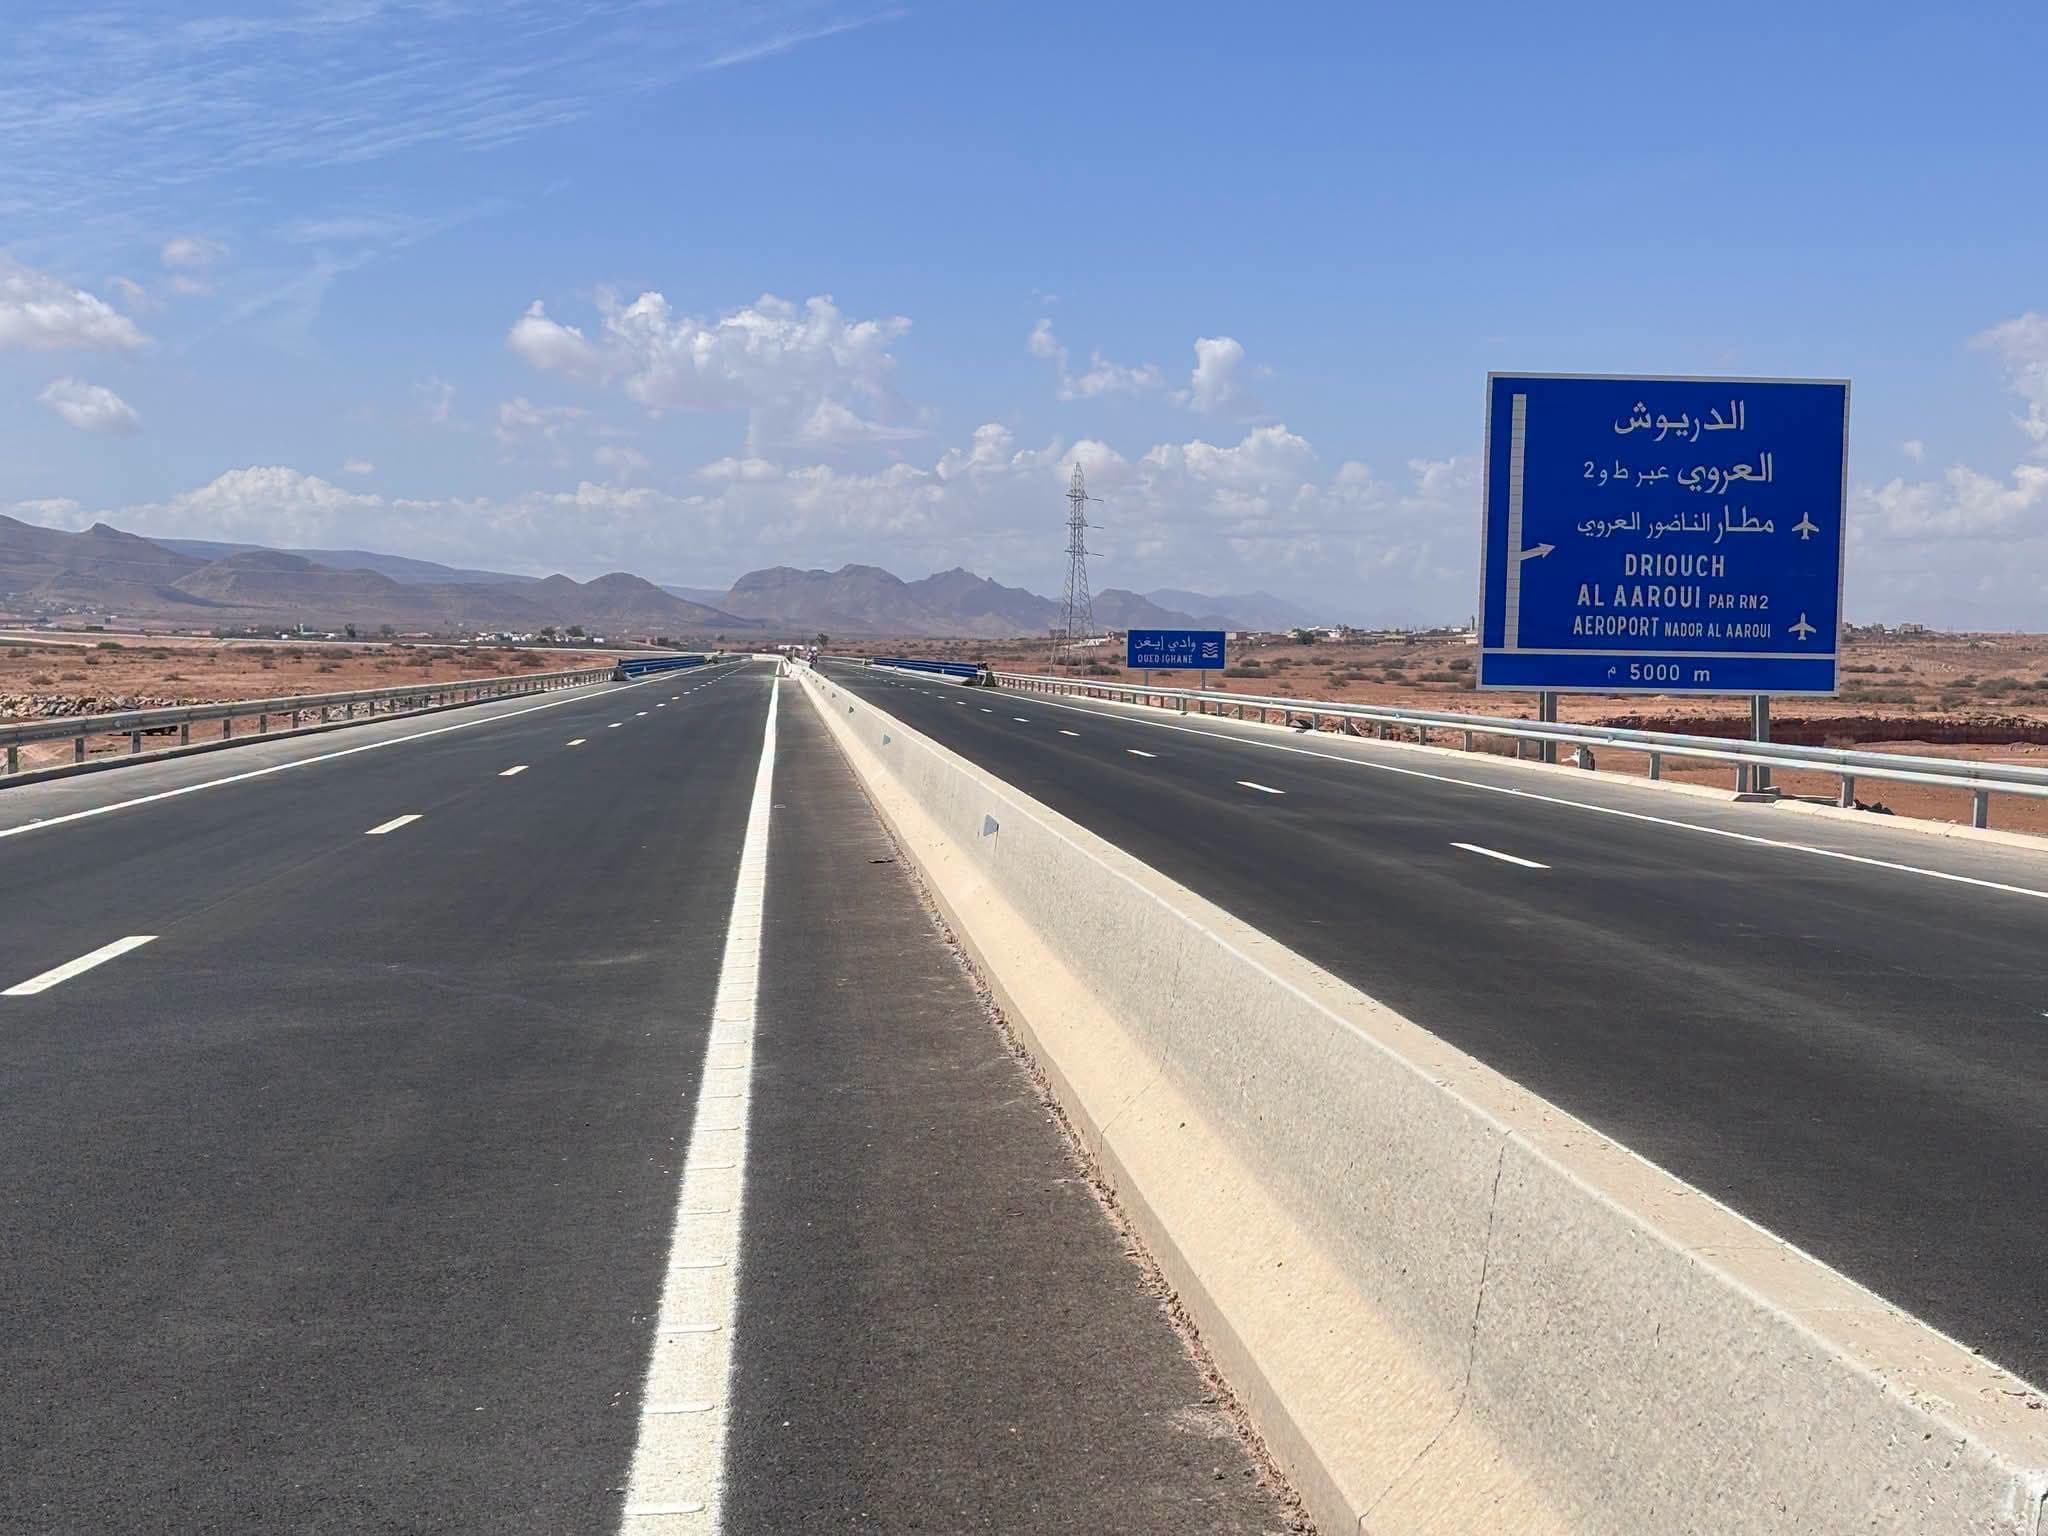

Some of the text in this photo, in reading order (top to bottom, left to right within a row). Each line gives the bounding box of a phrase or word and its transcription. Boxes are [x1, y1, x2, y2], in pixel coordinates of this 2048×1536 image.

[1614, 400, 1744, 442] الدريوش
[1637, 466, 1669, 487] عبر
[1678, 452, 1772, 493] العروي
[1577, 505, 1774, 543] مطار الناضور العروي
[1625, 554, 1725, 577] DRIOUCH
[1578, 584, 1768, 609] AL AAROUI PAR RN2
[1573, 616, 1771, 638] AEROPORT NADOR AL AAROUI
[1138, 654, 1192, 664] OUED IGHANE
[1630, 664, 1680, 681] 5000
[1694, 669, 1710, 682] m
